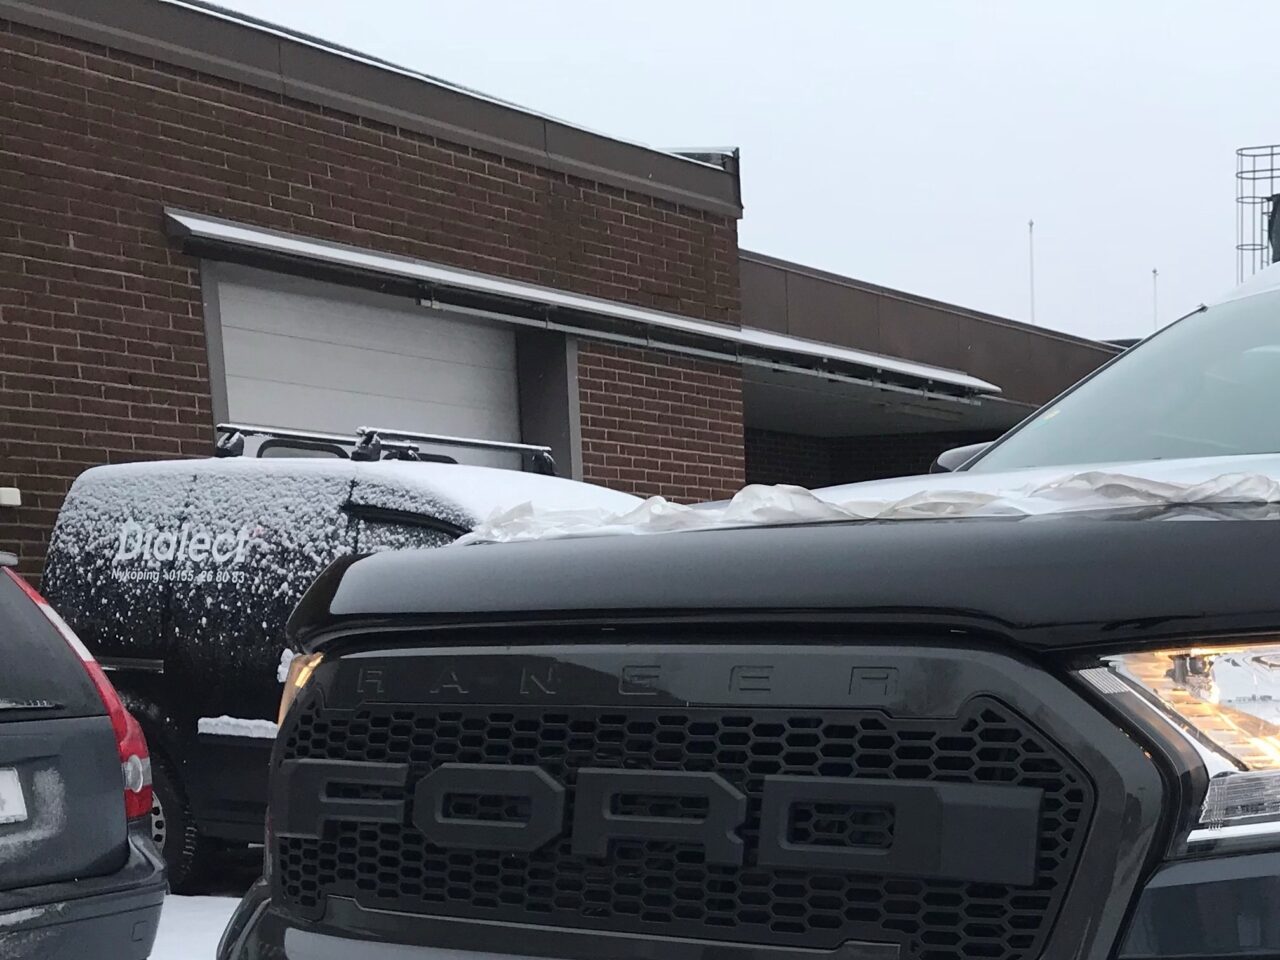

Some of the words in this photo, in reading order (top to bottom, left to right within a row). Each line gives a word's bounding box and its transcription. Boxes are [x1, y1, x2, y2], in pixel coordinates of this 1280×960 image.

[115, 519, 250, 563] Dialect
[111, 568, 160, 584] Nyköping
[216, 570, 229, 583] 80
[232, 571, 245, 584] 83
[355, 663, 900, 697] RANGER
[274, 758, 1044, 886] FORD
